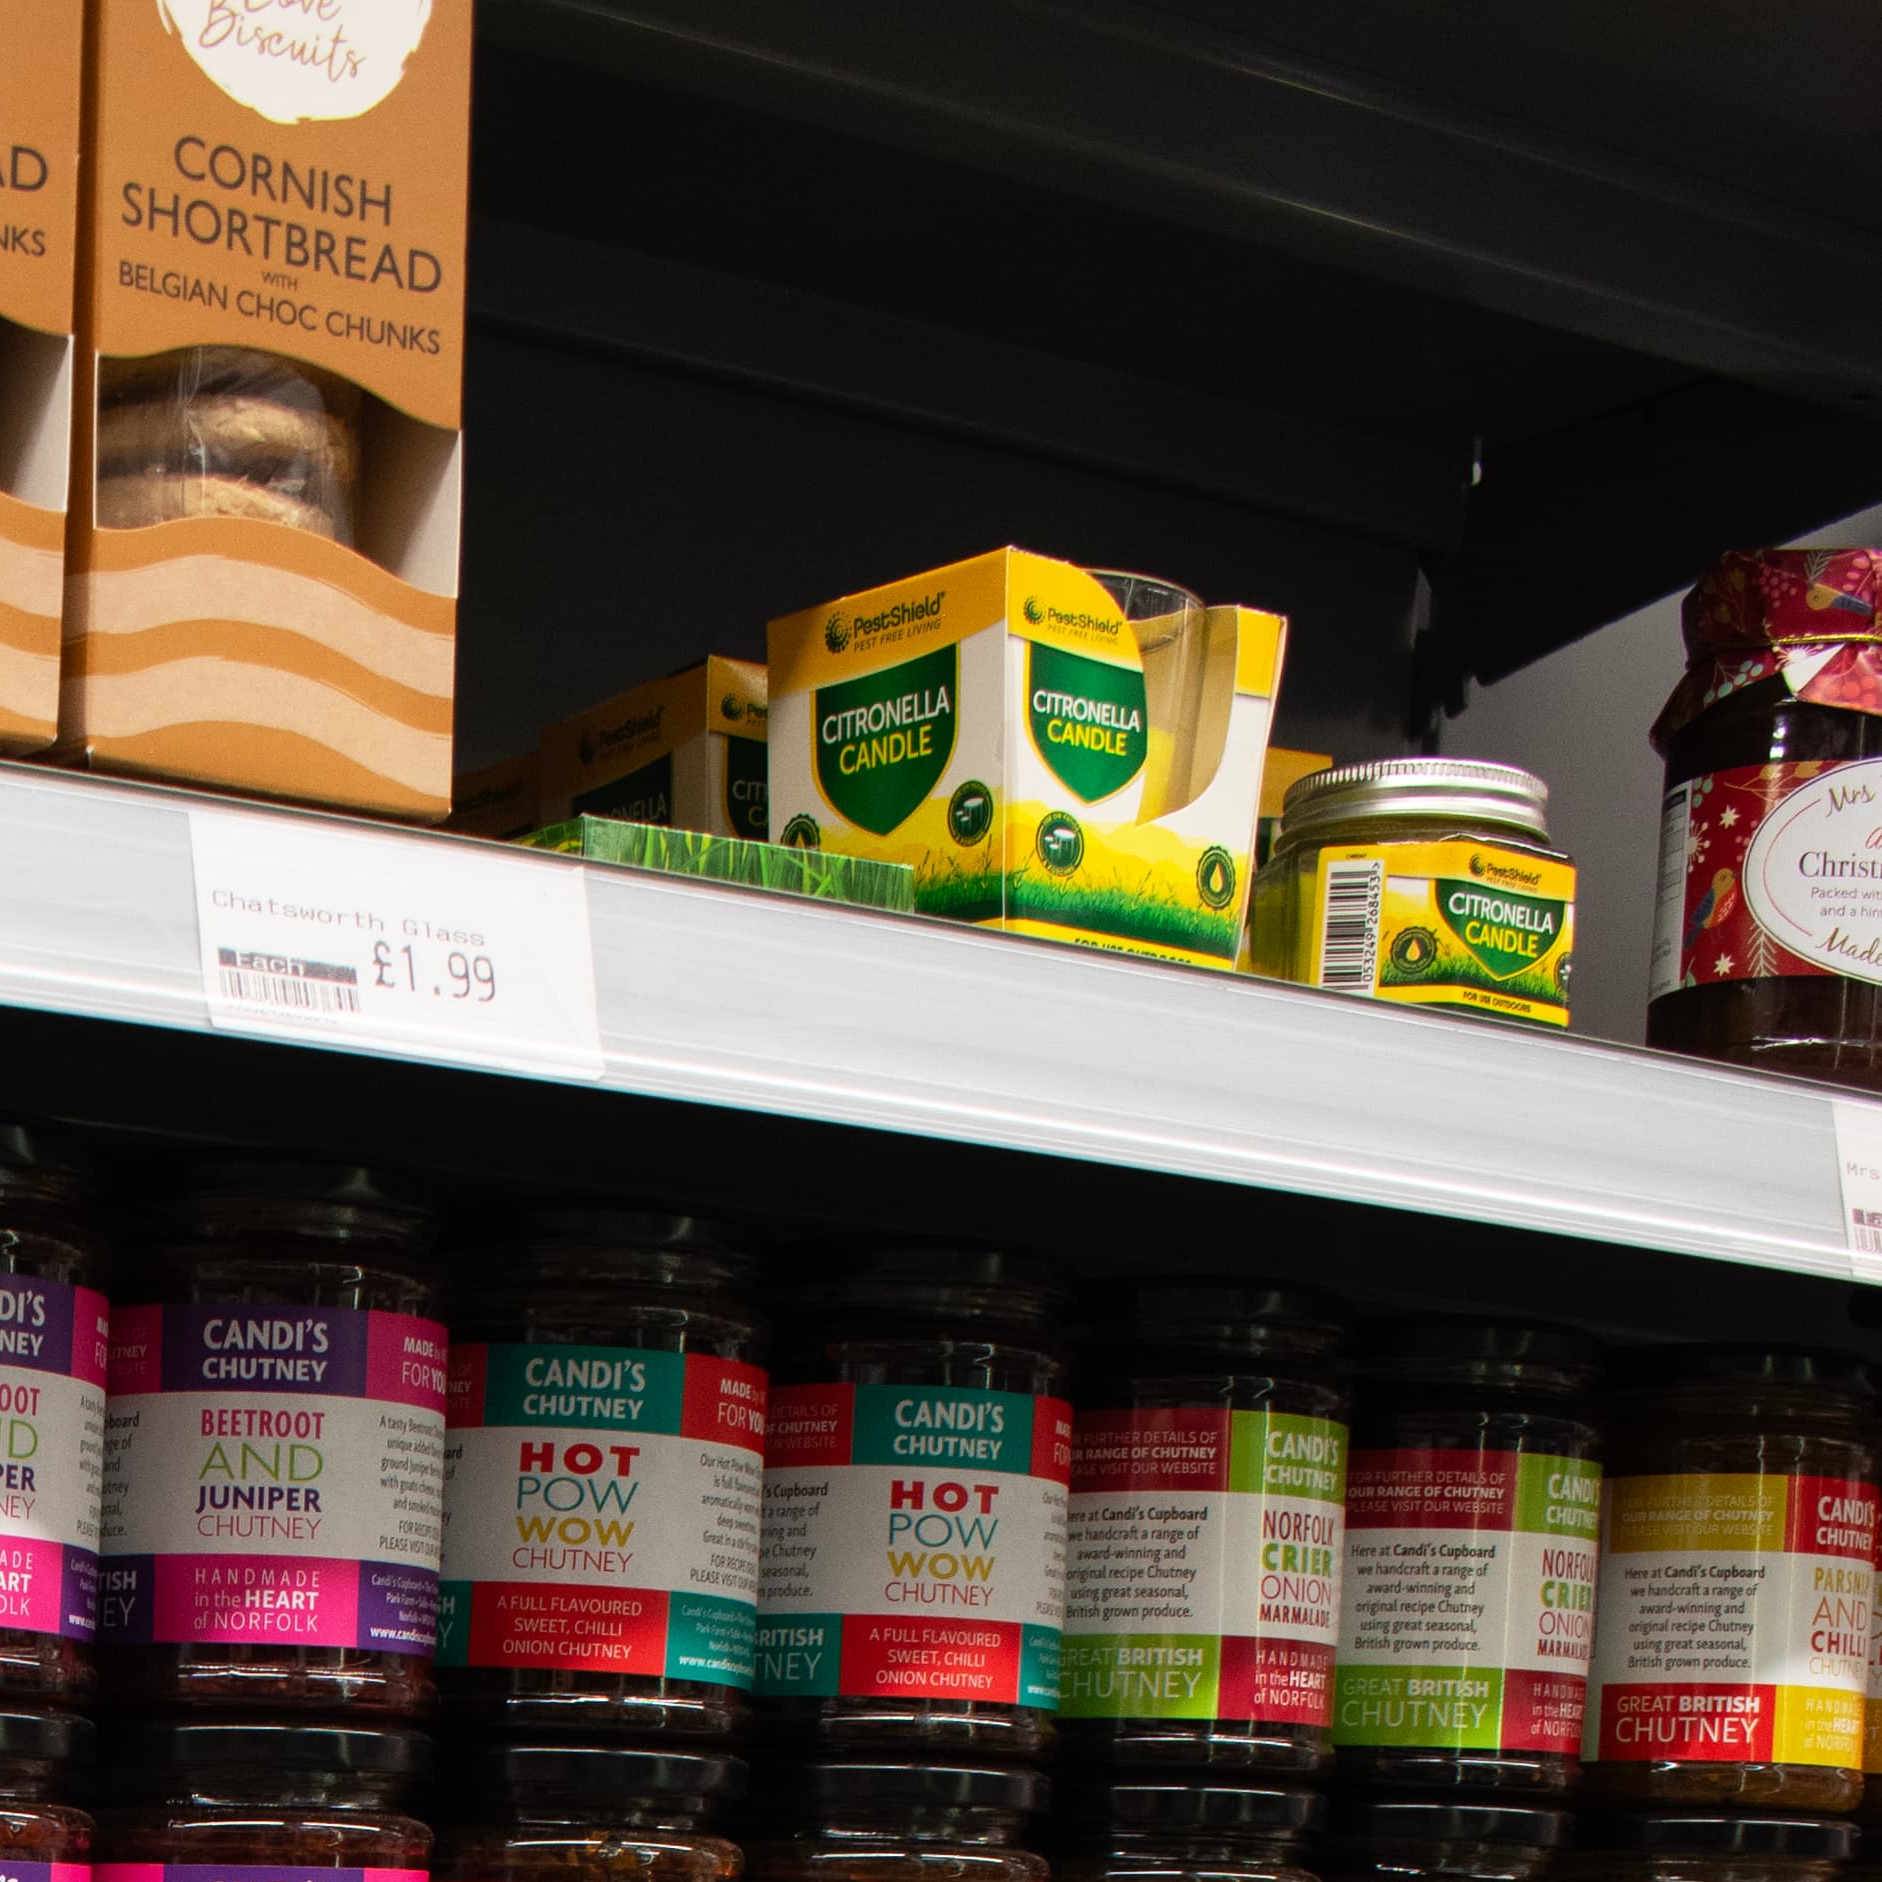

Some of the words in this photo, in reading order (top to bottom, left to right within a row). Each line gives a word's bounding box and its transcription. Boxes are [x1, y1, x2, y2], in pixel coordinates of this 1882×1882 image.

[198, 9, 365, 84] Biscuits
[174, 136, 392, 226] CORNISH
[121, 183, 443, 294] SHORTBREAD
[853, 593, 941, 638] PestShield
[853, 637, 877, 652] PEST
[879, 630, 903, 645] FREE
[907, 619, 941, 638] LIVING
[822, 685, 951, 745] CITRONELLA
[839, 723, 933, 776] CANDLE
[1826, 786, 1876, 817] Mrs
[1448, 893, 1555, 935] CITRONELLA
[1811, 887, 1857, 900] Packed
[212, 889, 386, 934] Chatsworth
[403, 918, 485, 948] Glass
[1464, 921, 1539, 956] CANDLE
[236, 951, 306, 976] Each
[371, 941, 497, 1003] £1.99
[519, 1441, 640, 1476] HOT
[518, 1476, 639, 1514] POW
[517, 1516, 634, 1547] WOW
